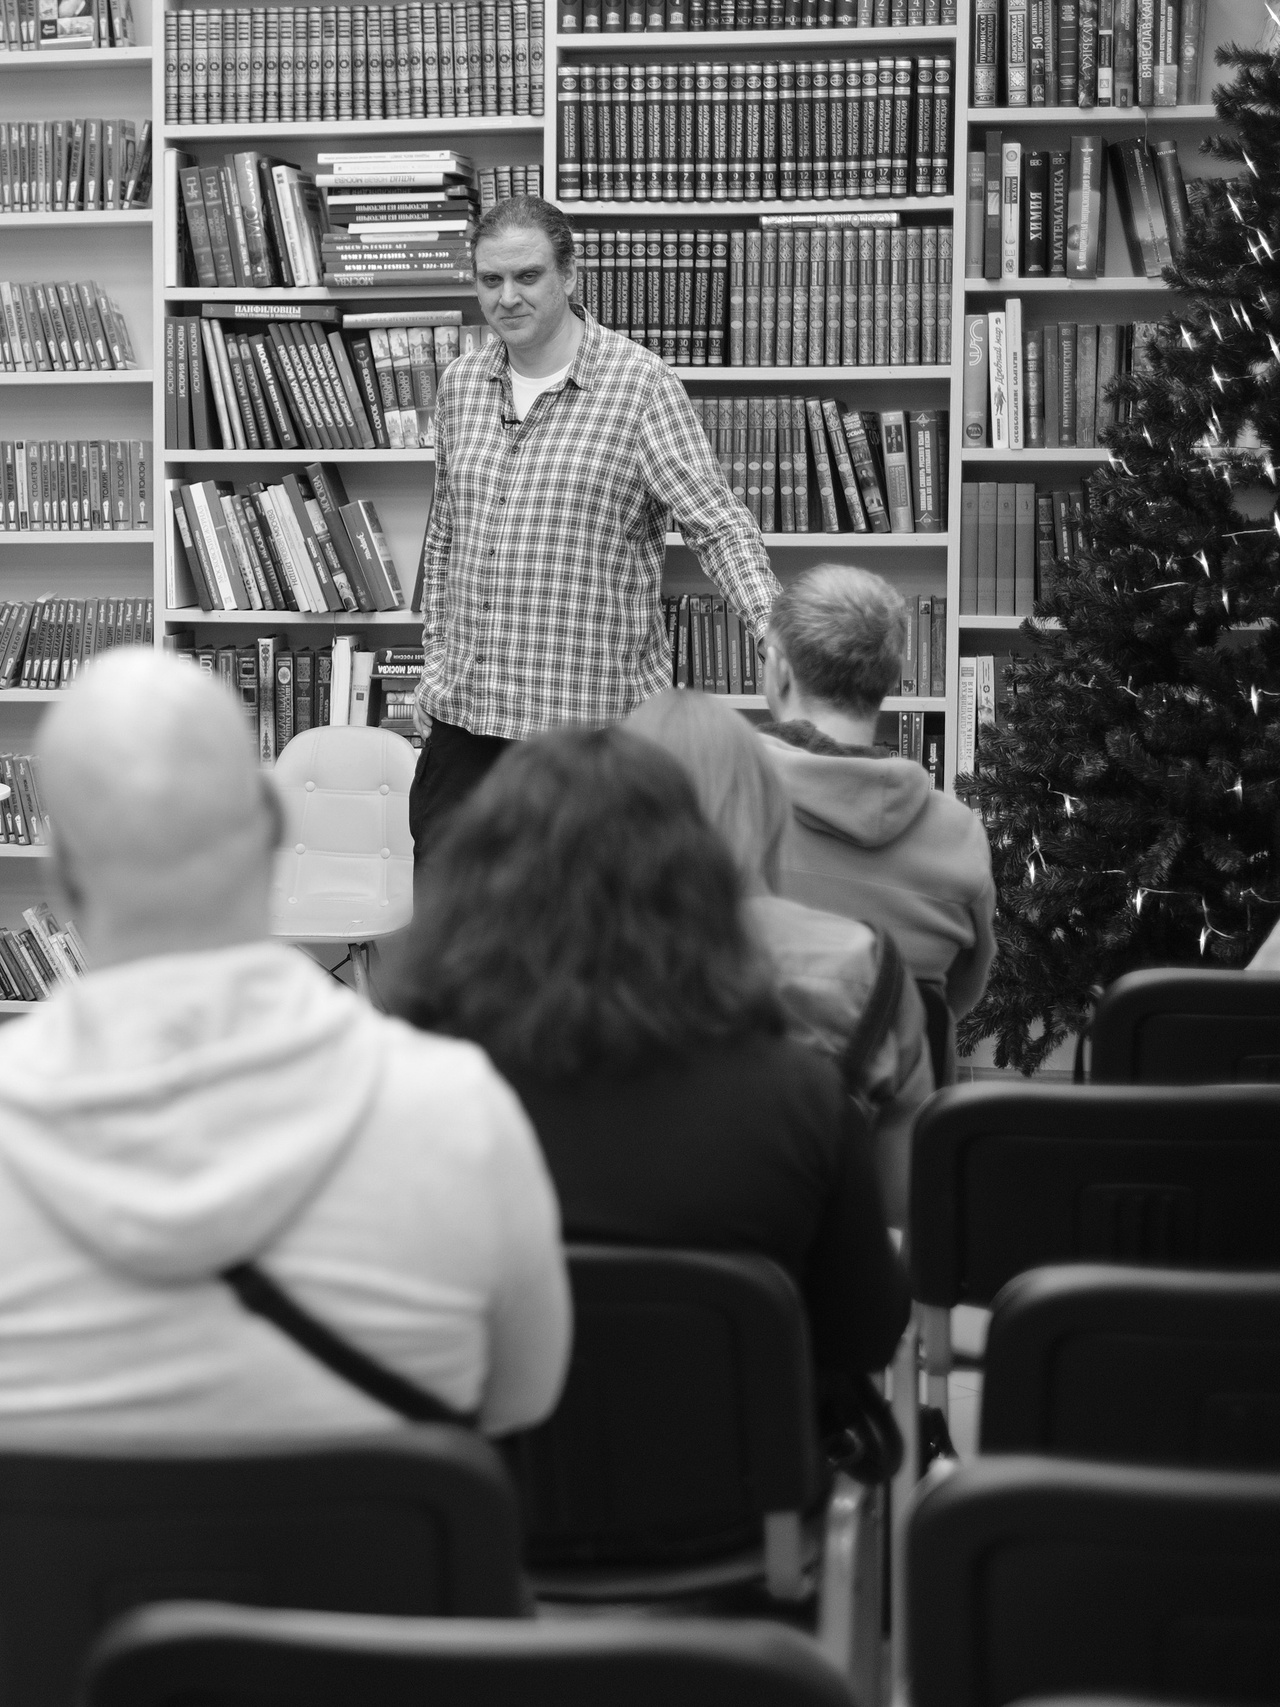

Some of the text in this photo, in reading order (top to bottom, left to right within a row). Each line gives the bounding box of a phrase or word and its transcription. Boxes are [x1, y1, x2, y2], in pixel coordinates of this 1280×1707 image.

[1032, 36, 1044, 50] 50
[1082, 16, 1093, 73] МУЗЫКА
[1142, 30, 1153, 79] ВЯЧЕСЛАВ
[1030, 192, 1043, 241] ХИМИЯ
[1053, 168, 1065, 262] МАТЕМАТИКА
[52, 308, 60, 320] ПО
[234, 305, 301, 314] ПАНФИЛОВЦЫ
[166, 324, 175, 395] ИСТОРИЯ МОСКВЫ
[190, 322, 201, 394] ИСТОРИЯ МОСКВЫ
[256, 343, 273, 381] МОСКВА
[277, 344, 312, 428] СИМВОЛИКА МОСКВЫ
[287, 344, 323, 428] СИМВОЛИКА МОСКВЫ
[298, 343, 334, 427] СИМВОЛИКА МОСКВЫ
[308, 343, 344, 427] СИМВОЛИКА МОСКВЫ
[319, 342, 355, 427] СИМВОЛИКА МОСКВЫ
[361, 367, 382, 429] СОРОК СОРОКОВ
[30, 461, 40, 498] СТОЛЕТОВ
[101, 472, 110, 500] ТОЛКИН
[116, 460, 126, 499] ЛЕВ ТОЛСТОЙ
[138, 460, 146, 488] ТОЛСТОЙ
[312, 475, 332, 513] МОСКВА
[196, 504, 211, 536] ЖУРНАЛ
[10, 630, 22, 655] ЧЕХОВ
[45, 622, 56, 658] ШАЛАМОВ
[53, 622, 64, 658] ШАЛАМОВ
[64, 622, 74, 658] ШАЛАМОВ
[85, 622, 94, 656] ШВЕЙЦЕР
[378, 664, 406, 674] МОСКВА
